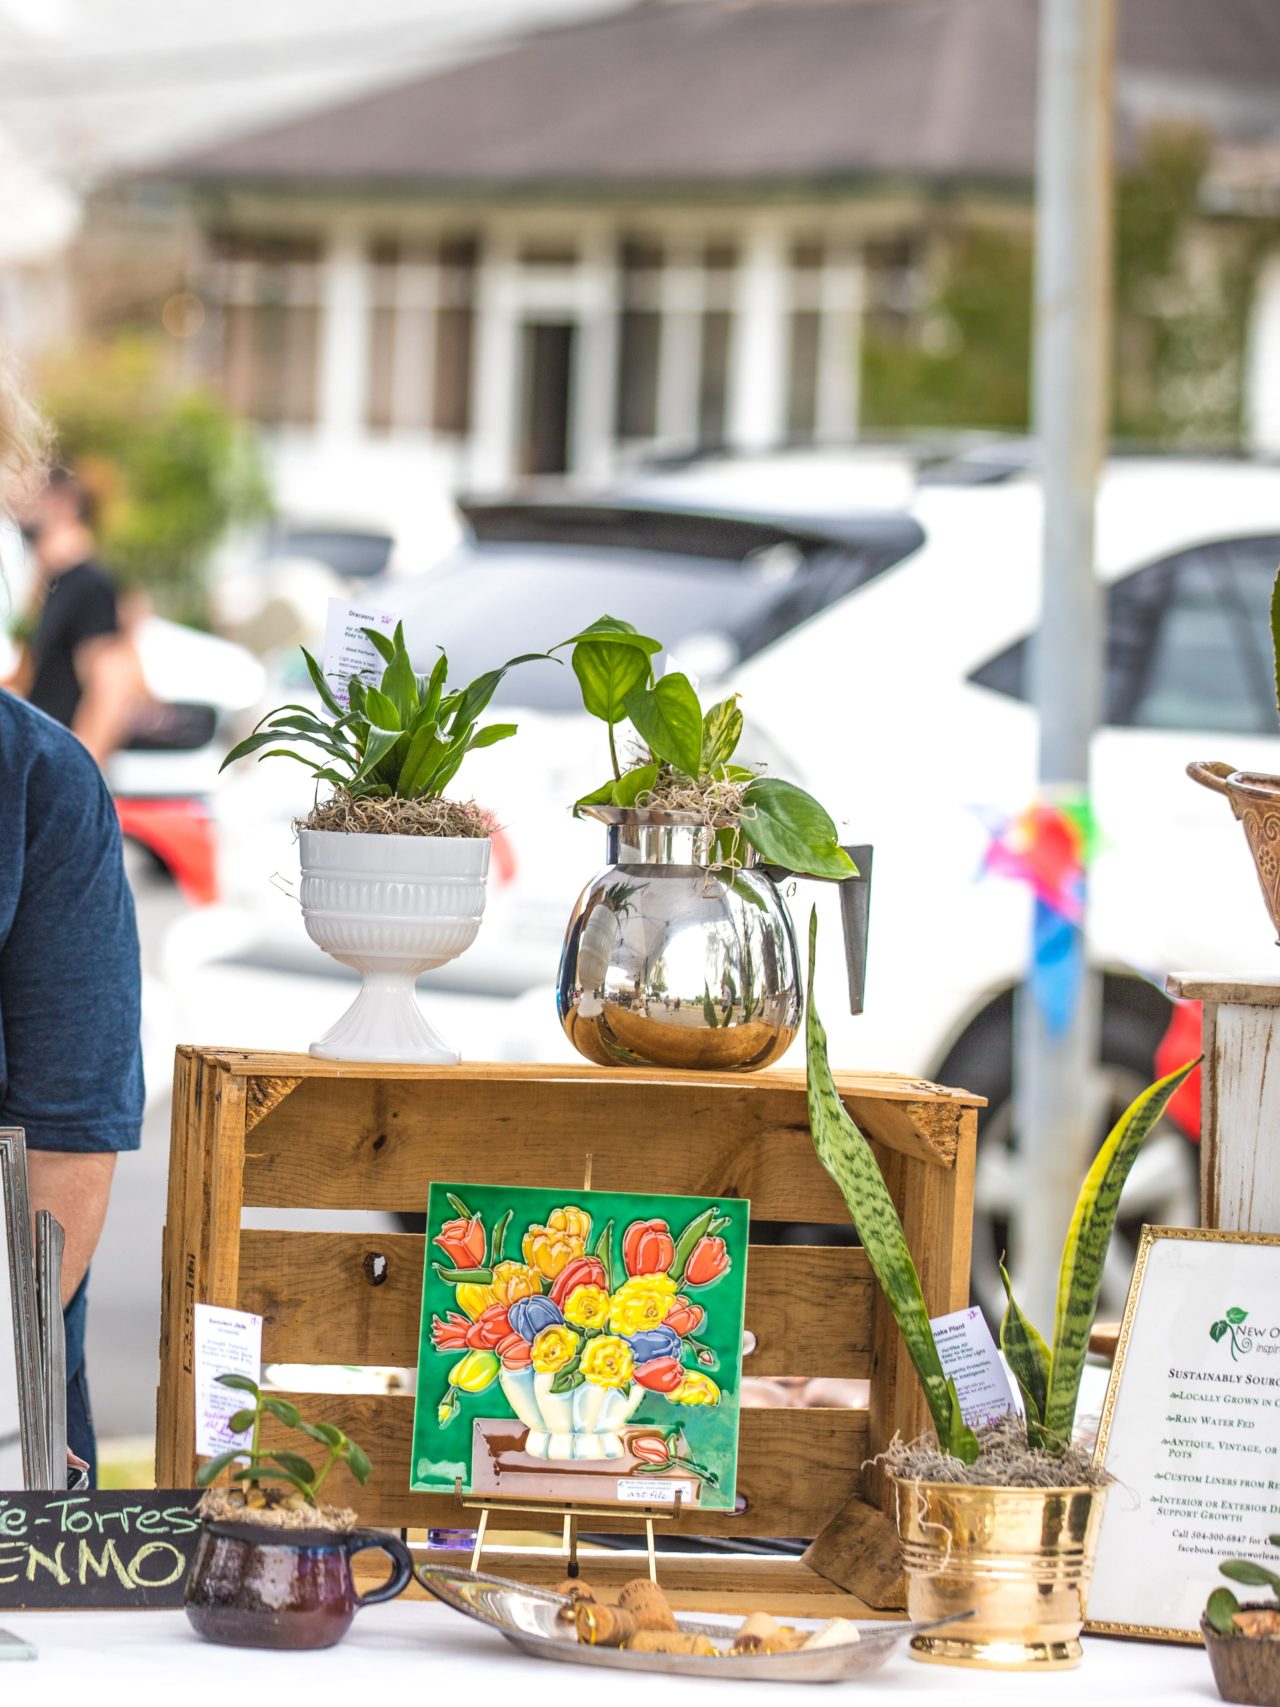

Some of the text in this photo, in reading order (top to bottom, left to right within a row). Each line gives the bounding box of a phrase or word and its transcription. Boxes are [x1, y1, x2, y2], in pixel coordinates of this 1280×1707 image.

[949, 1323, 965, 1332] Plant
[1168, 1368, 1243, 1384] SUSTAINABLY
[1180, 1391, 1221, 1403] LOCALLY
[1223, 1394, 1259, 1405] GROWN
[1261, 1399, 1272, 1407] IN
[1175, 1414, 1255, 1429] RAIN WATER FED
[1168, 1448, 1192, 1459] POTS
[1169, 1438, 1277, 1454] ANTIQUE, VINTAGE, OR
[1164, 1472, 1202, 1483] CUSTOM
[1205, 1475, 1237, 1487] LINERS
[1239, 1479, 1265, 1489] FROM
[1159, 1495, 1203, 1507] INTERIOR
[1205, 1500, 1218, 1509] OR
[1221, 1500, 1267, 1513] EXTERIOR
[1156, 1506, 1243, 1522] SUPPORT GROWTH
[1172, 1529, 1189, 1538] Call
[1249, 1536, 1261, 1545] for
